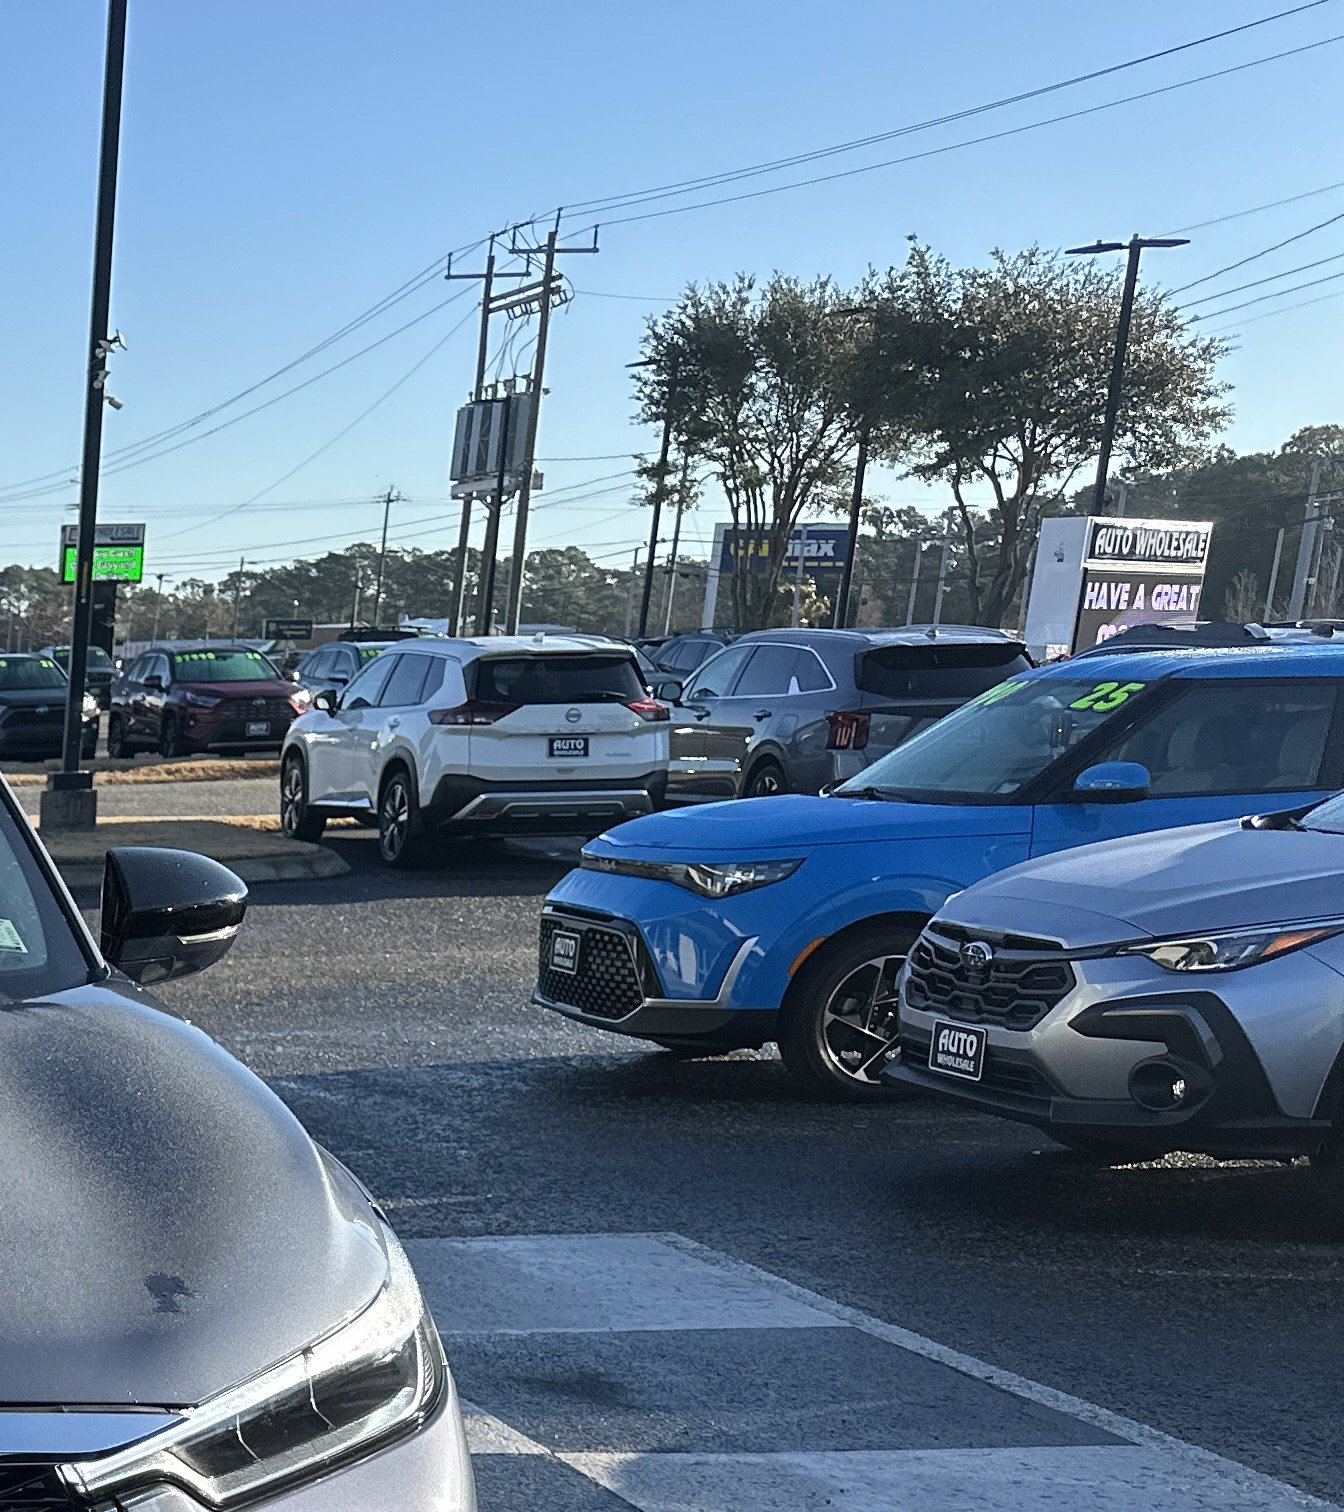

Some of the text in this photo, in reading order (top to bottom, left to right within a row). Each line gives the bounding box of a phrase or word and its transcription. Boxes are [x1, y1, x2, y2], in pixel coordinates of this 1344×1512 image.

[1095, 527, 1207, 559] AUTO WHOLESALE
[1084, 582, 1201, 610] HAVE A GREAT
[1069, 682, 1146, 712] 25
[553, 739, 584, 750] AUTO
[555, 937, 575, 957] AUTO
[939, 1029, 977, 1057] AUTO
